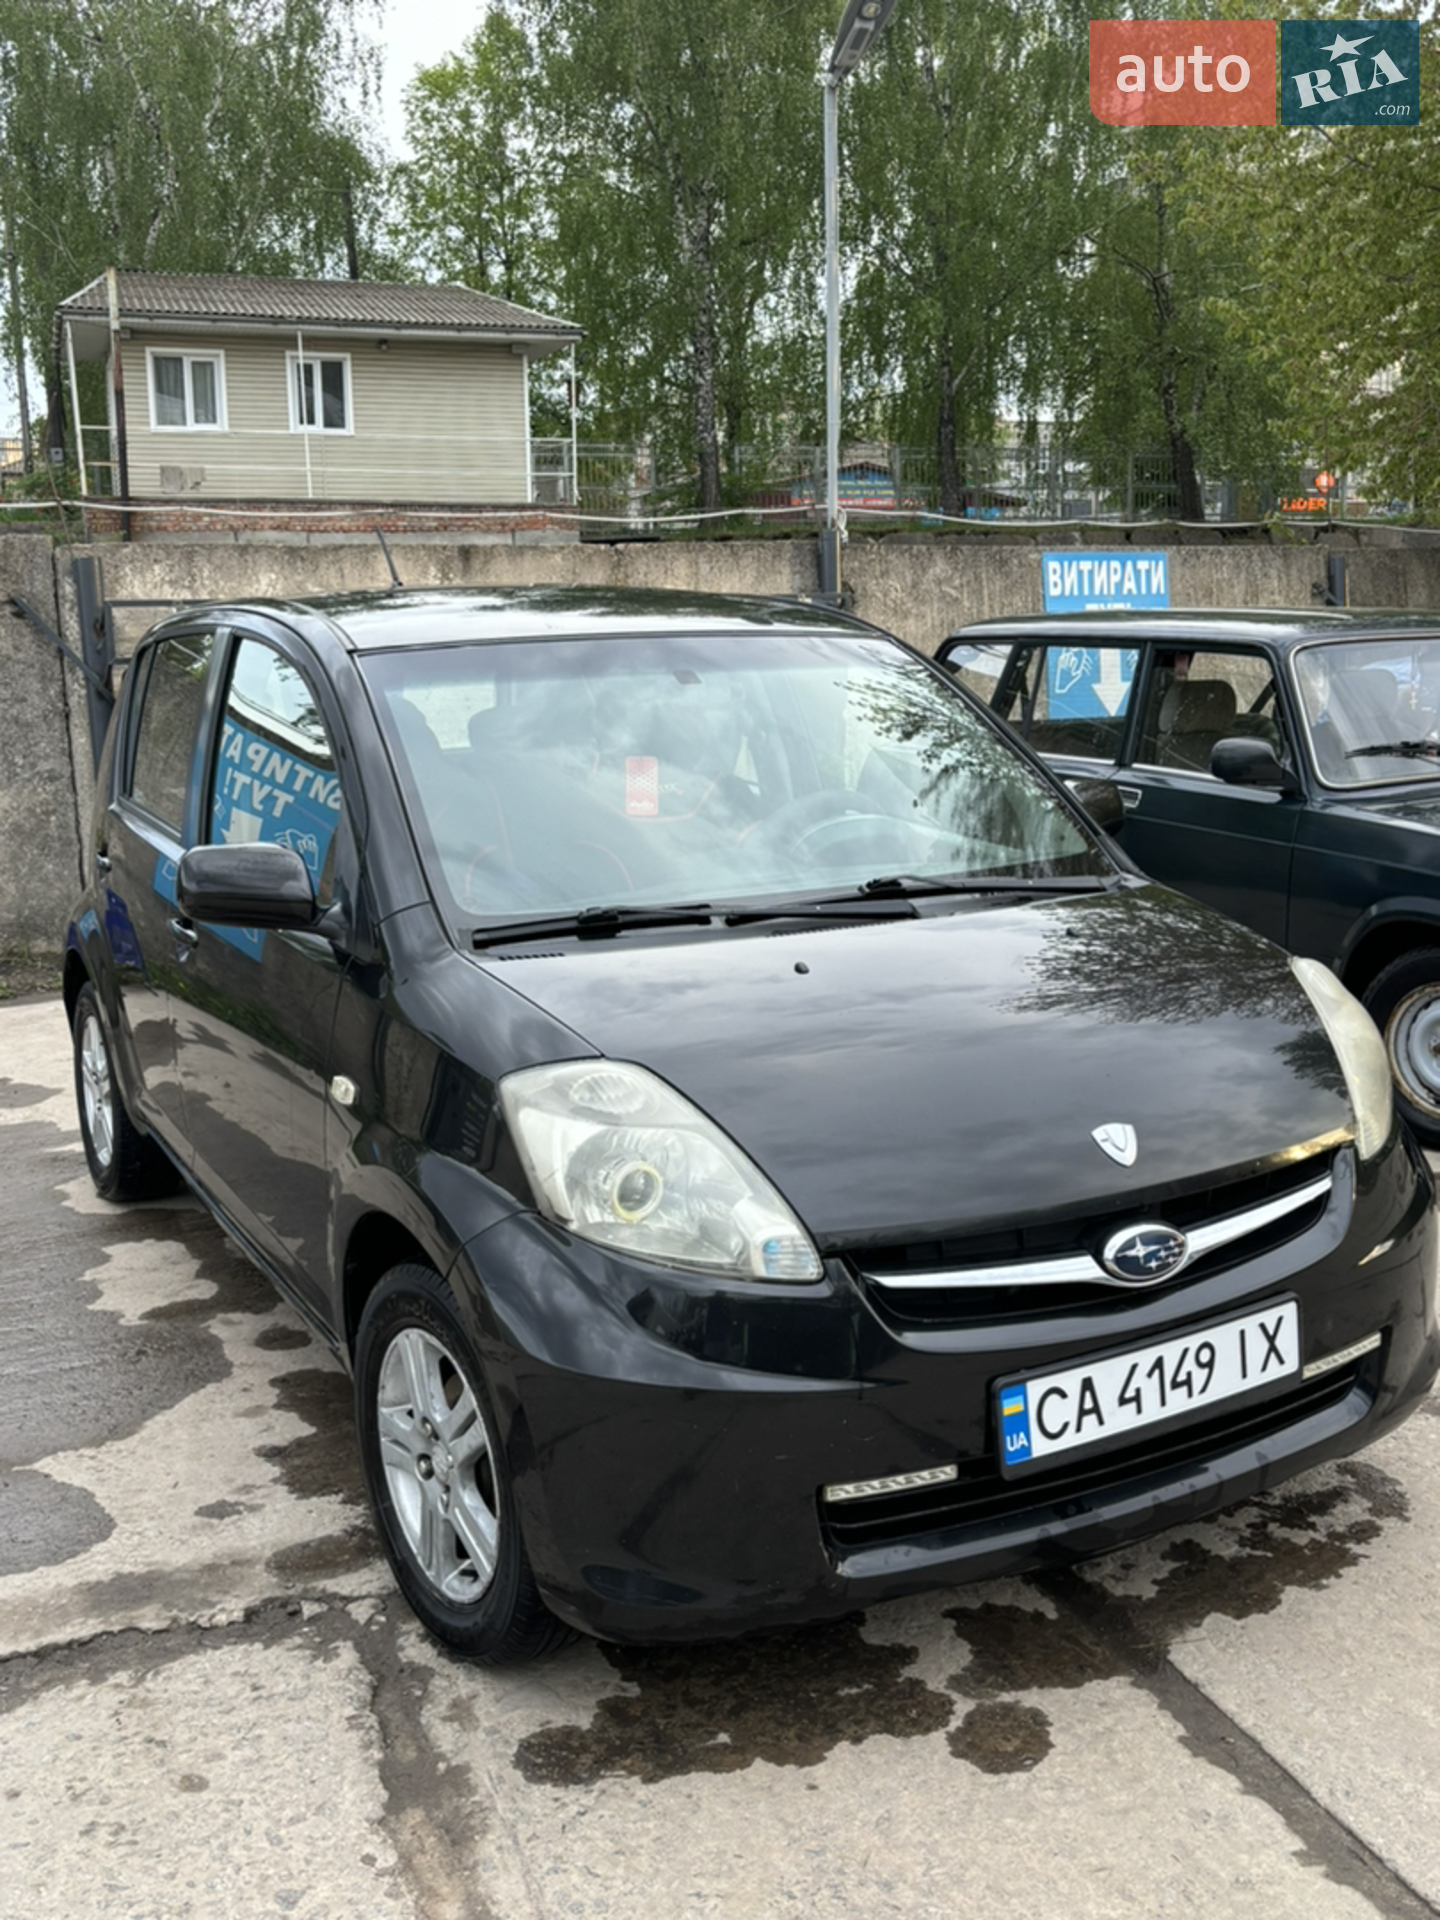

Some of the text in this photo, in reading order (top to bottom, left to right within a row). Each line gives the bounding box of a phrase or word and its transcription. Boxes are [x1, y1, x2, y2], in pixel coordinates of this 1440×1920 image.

[1047, 559, 1166, 598] ВИТИРАТИ
[1036, 1315, 1286, 1440] CA 4149 IX
[1005, 1432, 1029, 1452] UA
